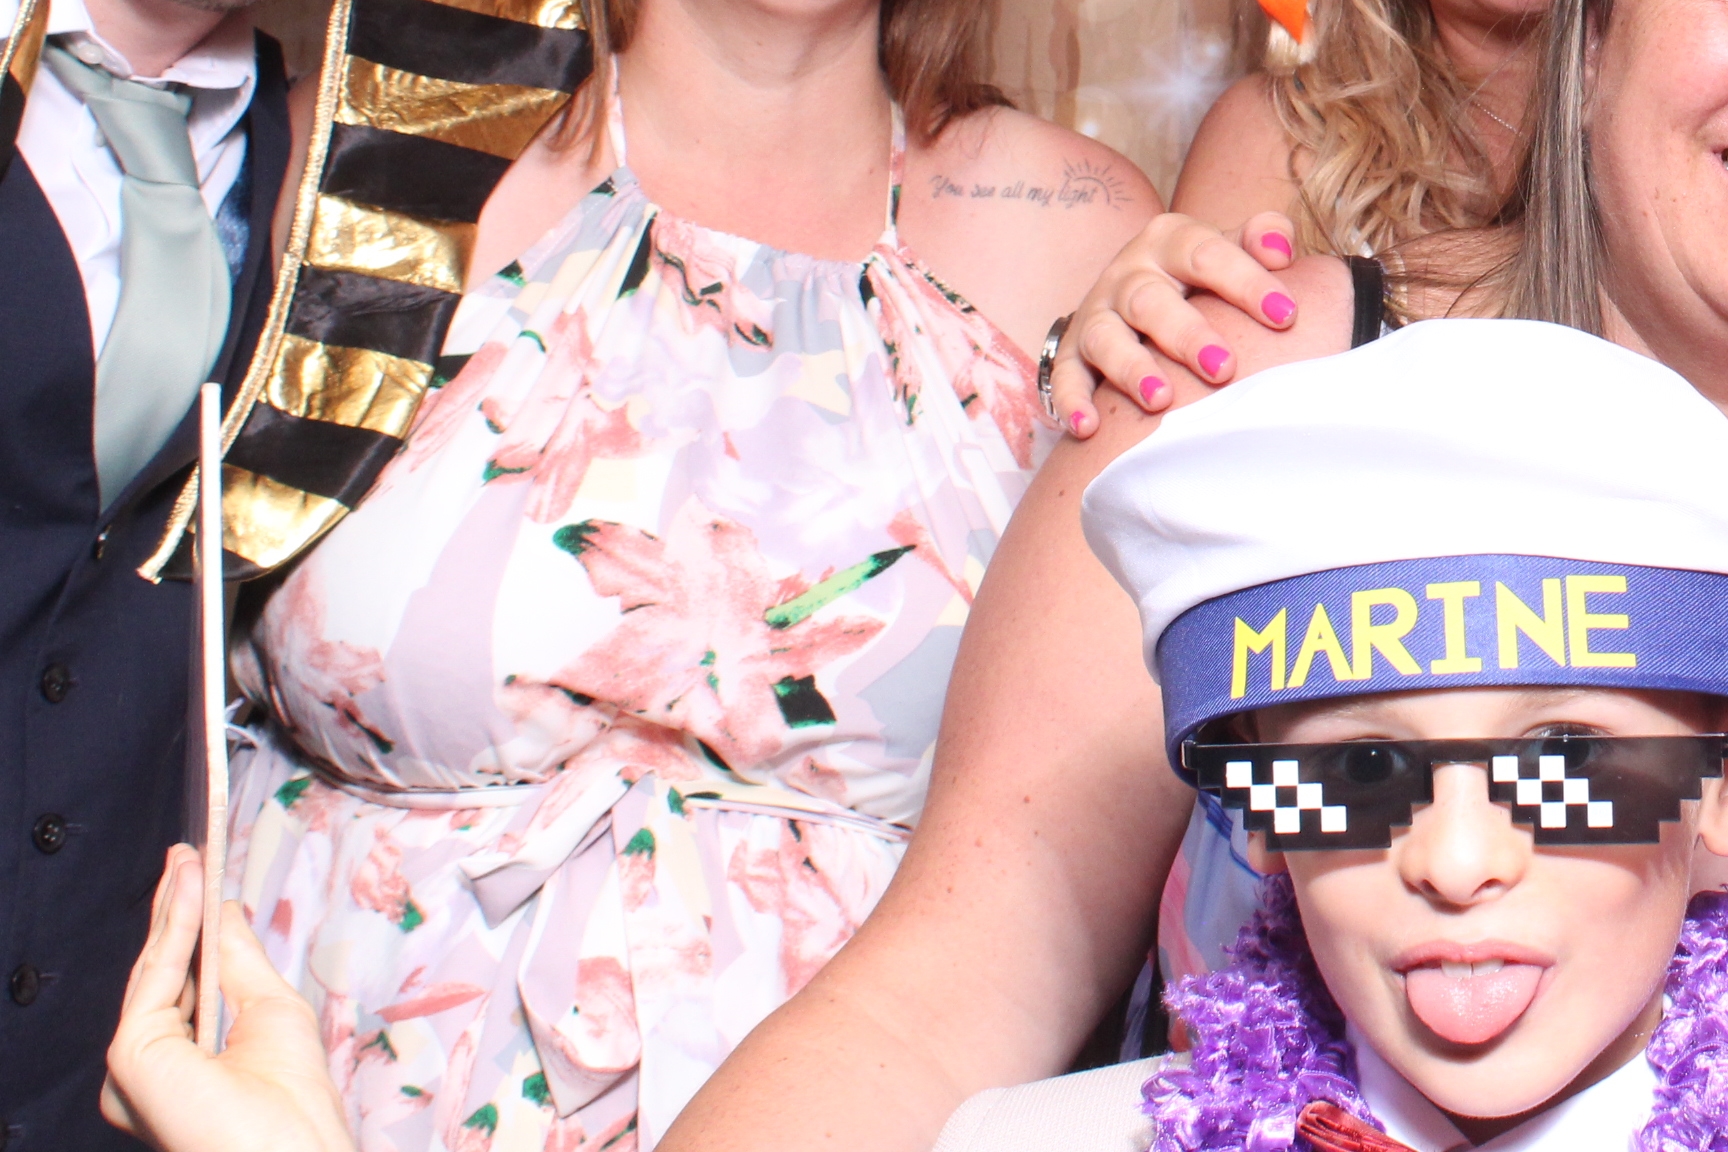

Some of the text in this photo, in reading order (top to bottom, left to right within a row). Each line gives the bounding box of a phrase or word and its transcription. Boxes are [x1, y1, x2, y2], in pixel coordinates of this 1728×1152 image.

[928, 174, 1099, 209] You see all my light
[1230, 574, 1637, 700] MARINE
